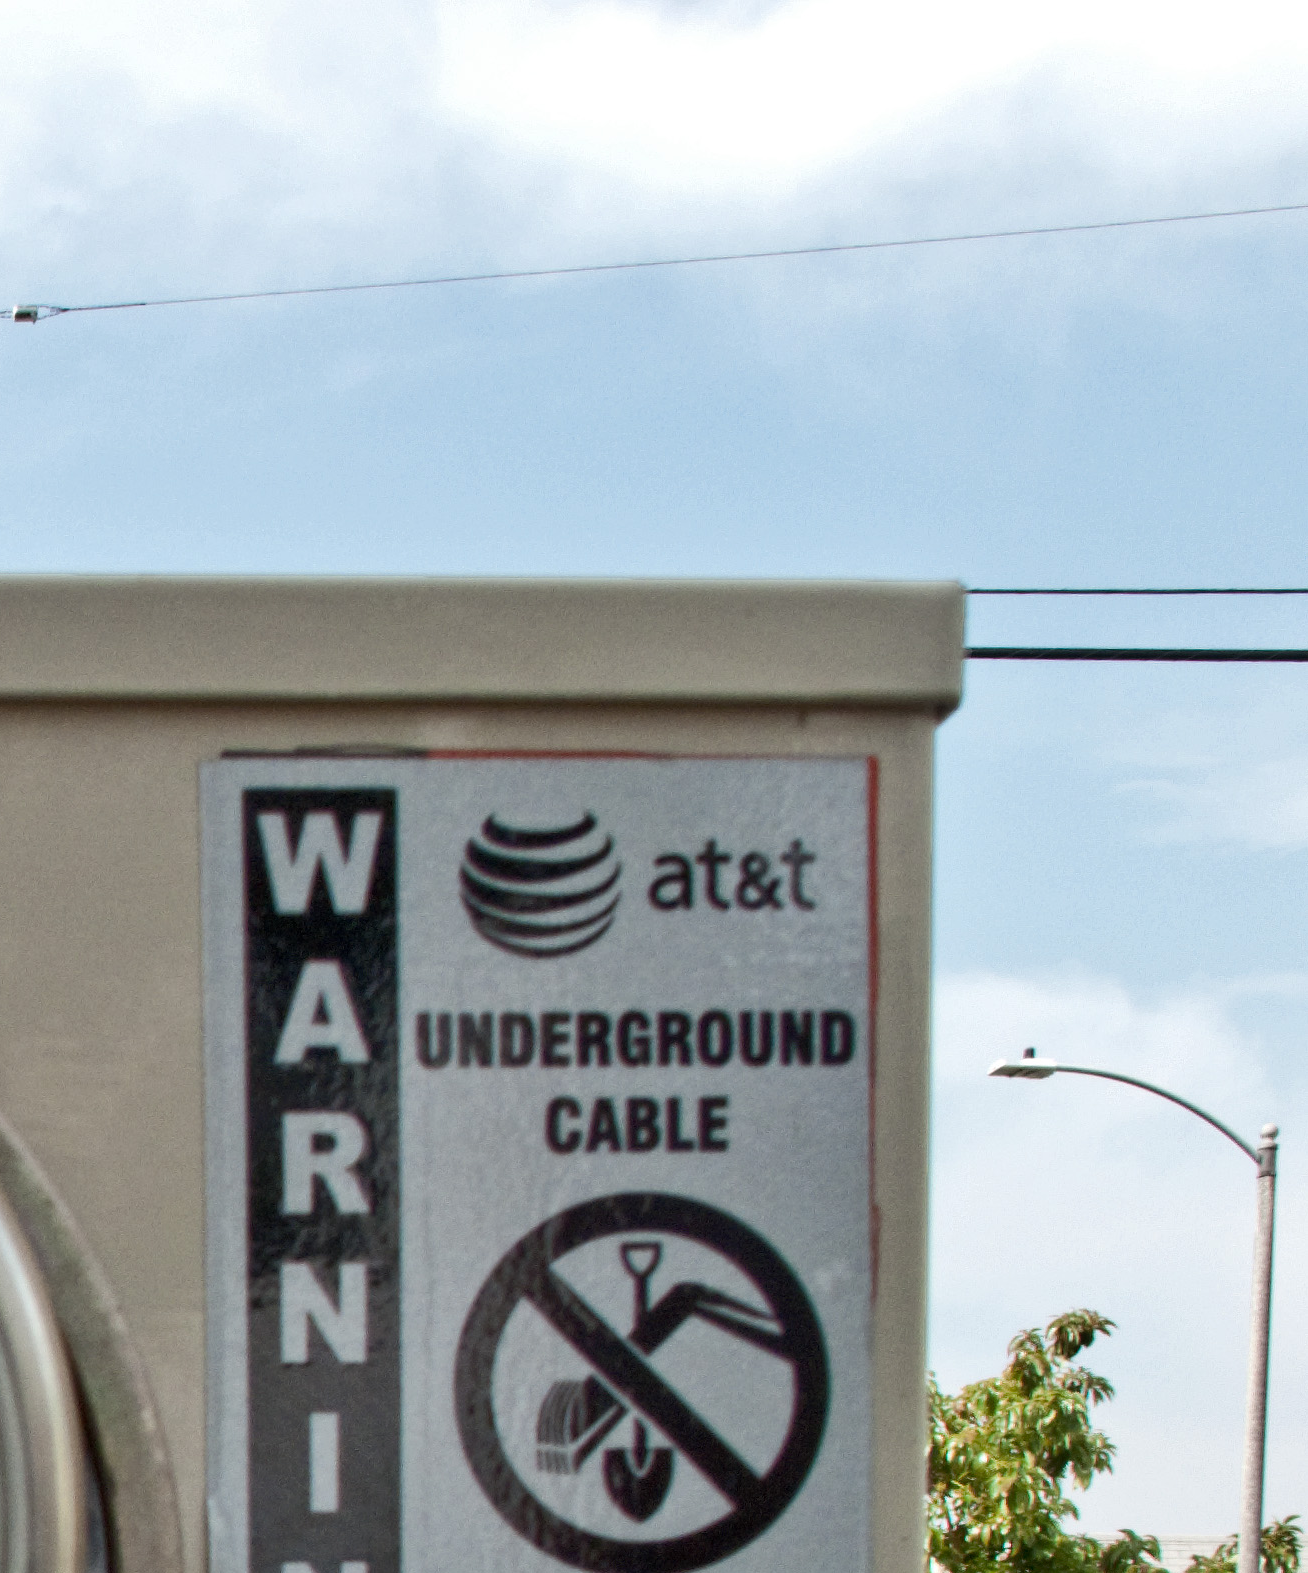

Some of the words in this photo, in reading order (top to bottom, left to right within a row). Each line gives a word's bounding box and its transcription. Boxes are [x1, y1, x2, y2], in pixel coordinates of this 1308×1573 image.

[647, 839, 817, 912] at&t
[416, 1010, 857, 1070] UNDERGROUND
[545, 1096, 729, 1154] CABLE
